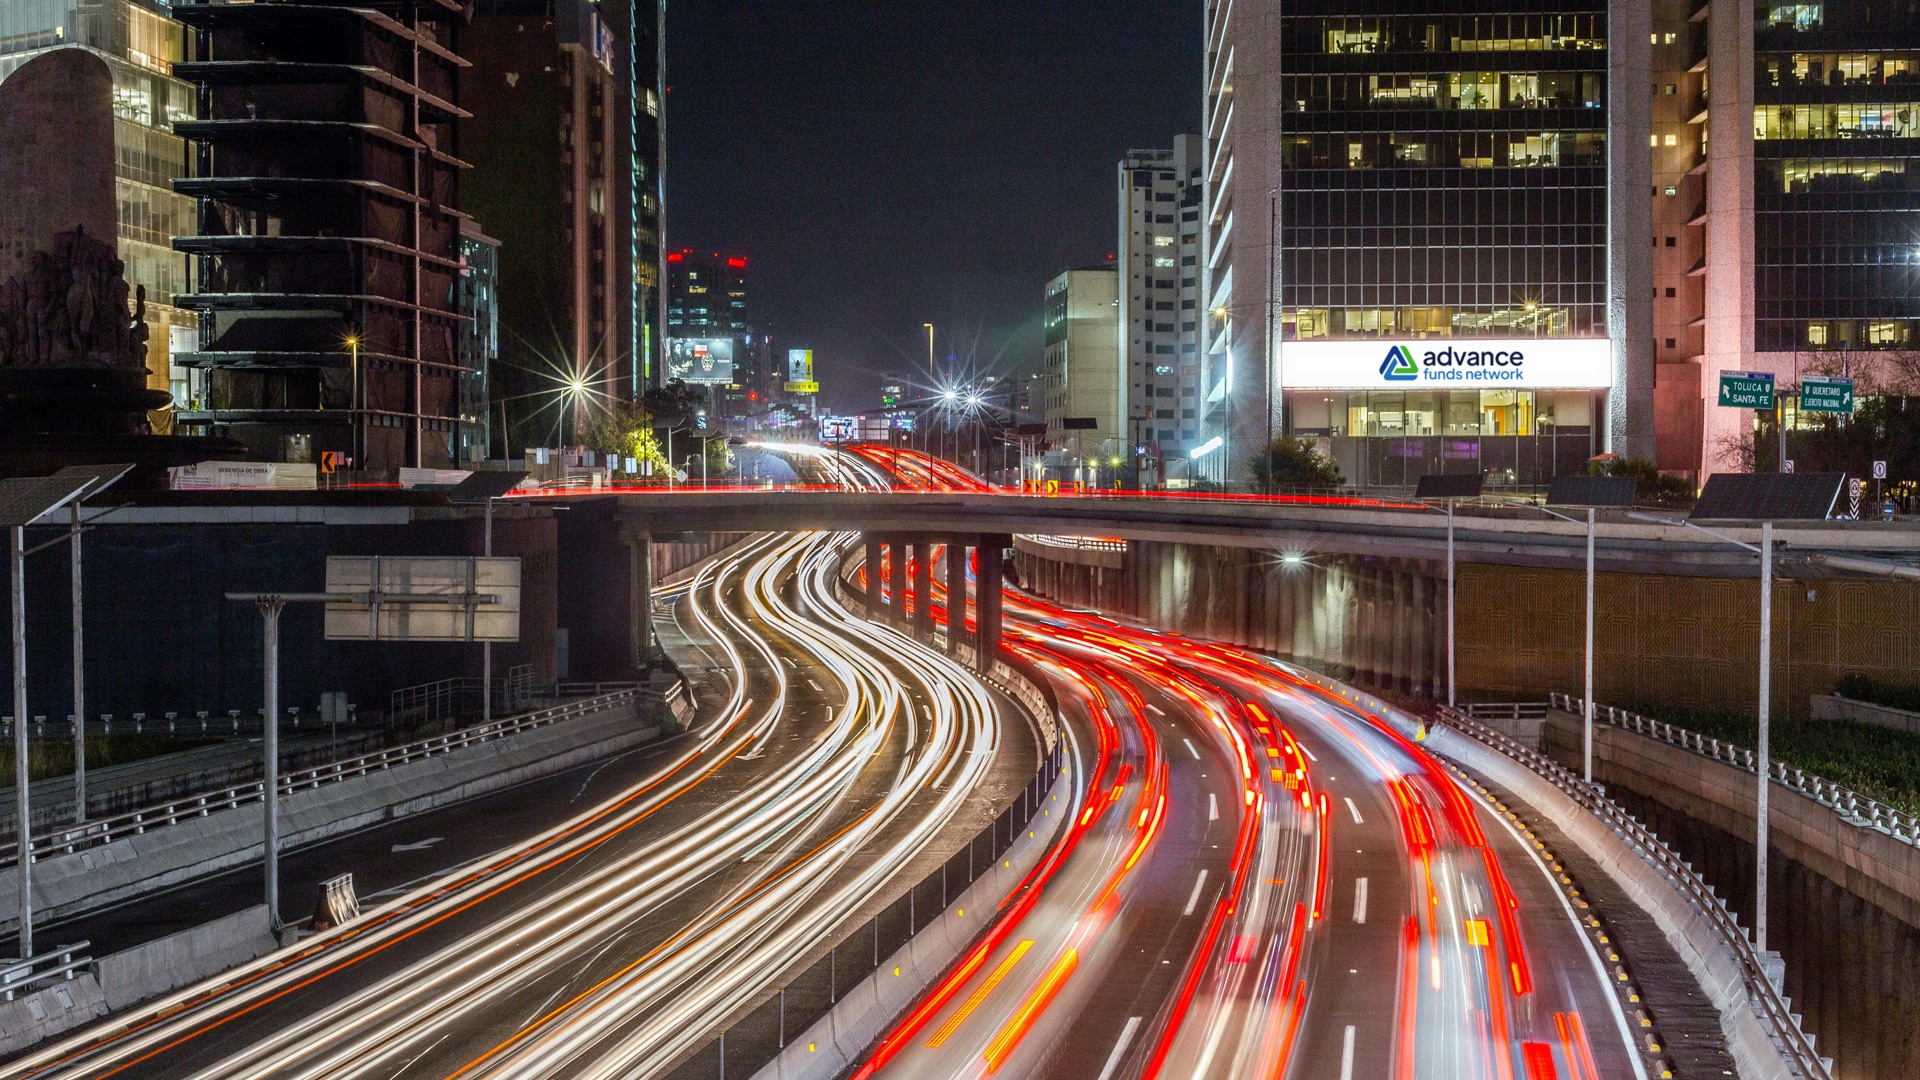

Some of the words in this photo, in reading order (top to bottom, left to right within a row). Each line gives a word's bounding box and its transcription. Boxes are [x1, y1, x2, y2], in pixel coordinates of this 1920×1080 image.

[1423, 346, 1524, 366] advance
[1423, 368, 1463, 380] funds
[1466, 368, 1524, 380] network
[1733, 382, 1762, 392] TOLUCA
[1812, 386, 1841, 396] QUERETARO
[1732, 394, 1756, 404] SANTA
[1759, 395, 1769, 405] FE
[1804, 397, 1822, 407] EJERCITO
[1822, 399, 1840, 408] NACIONAL
